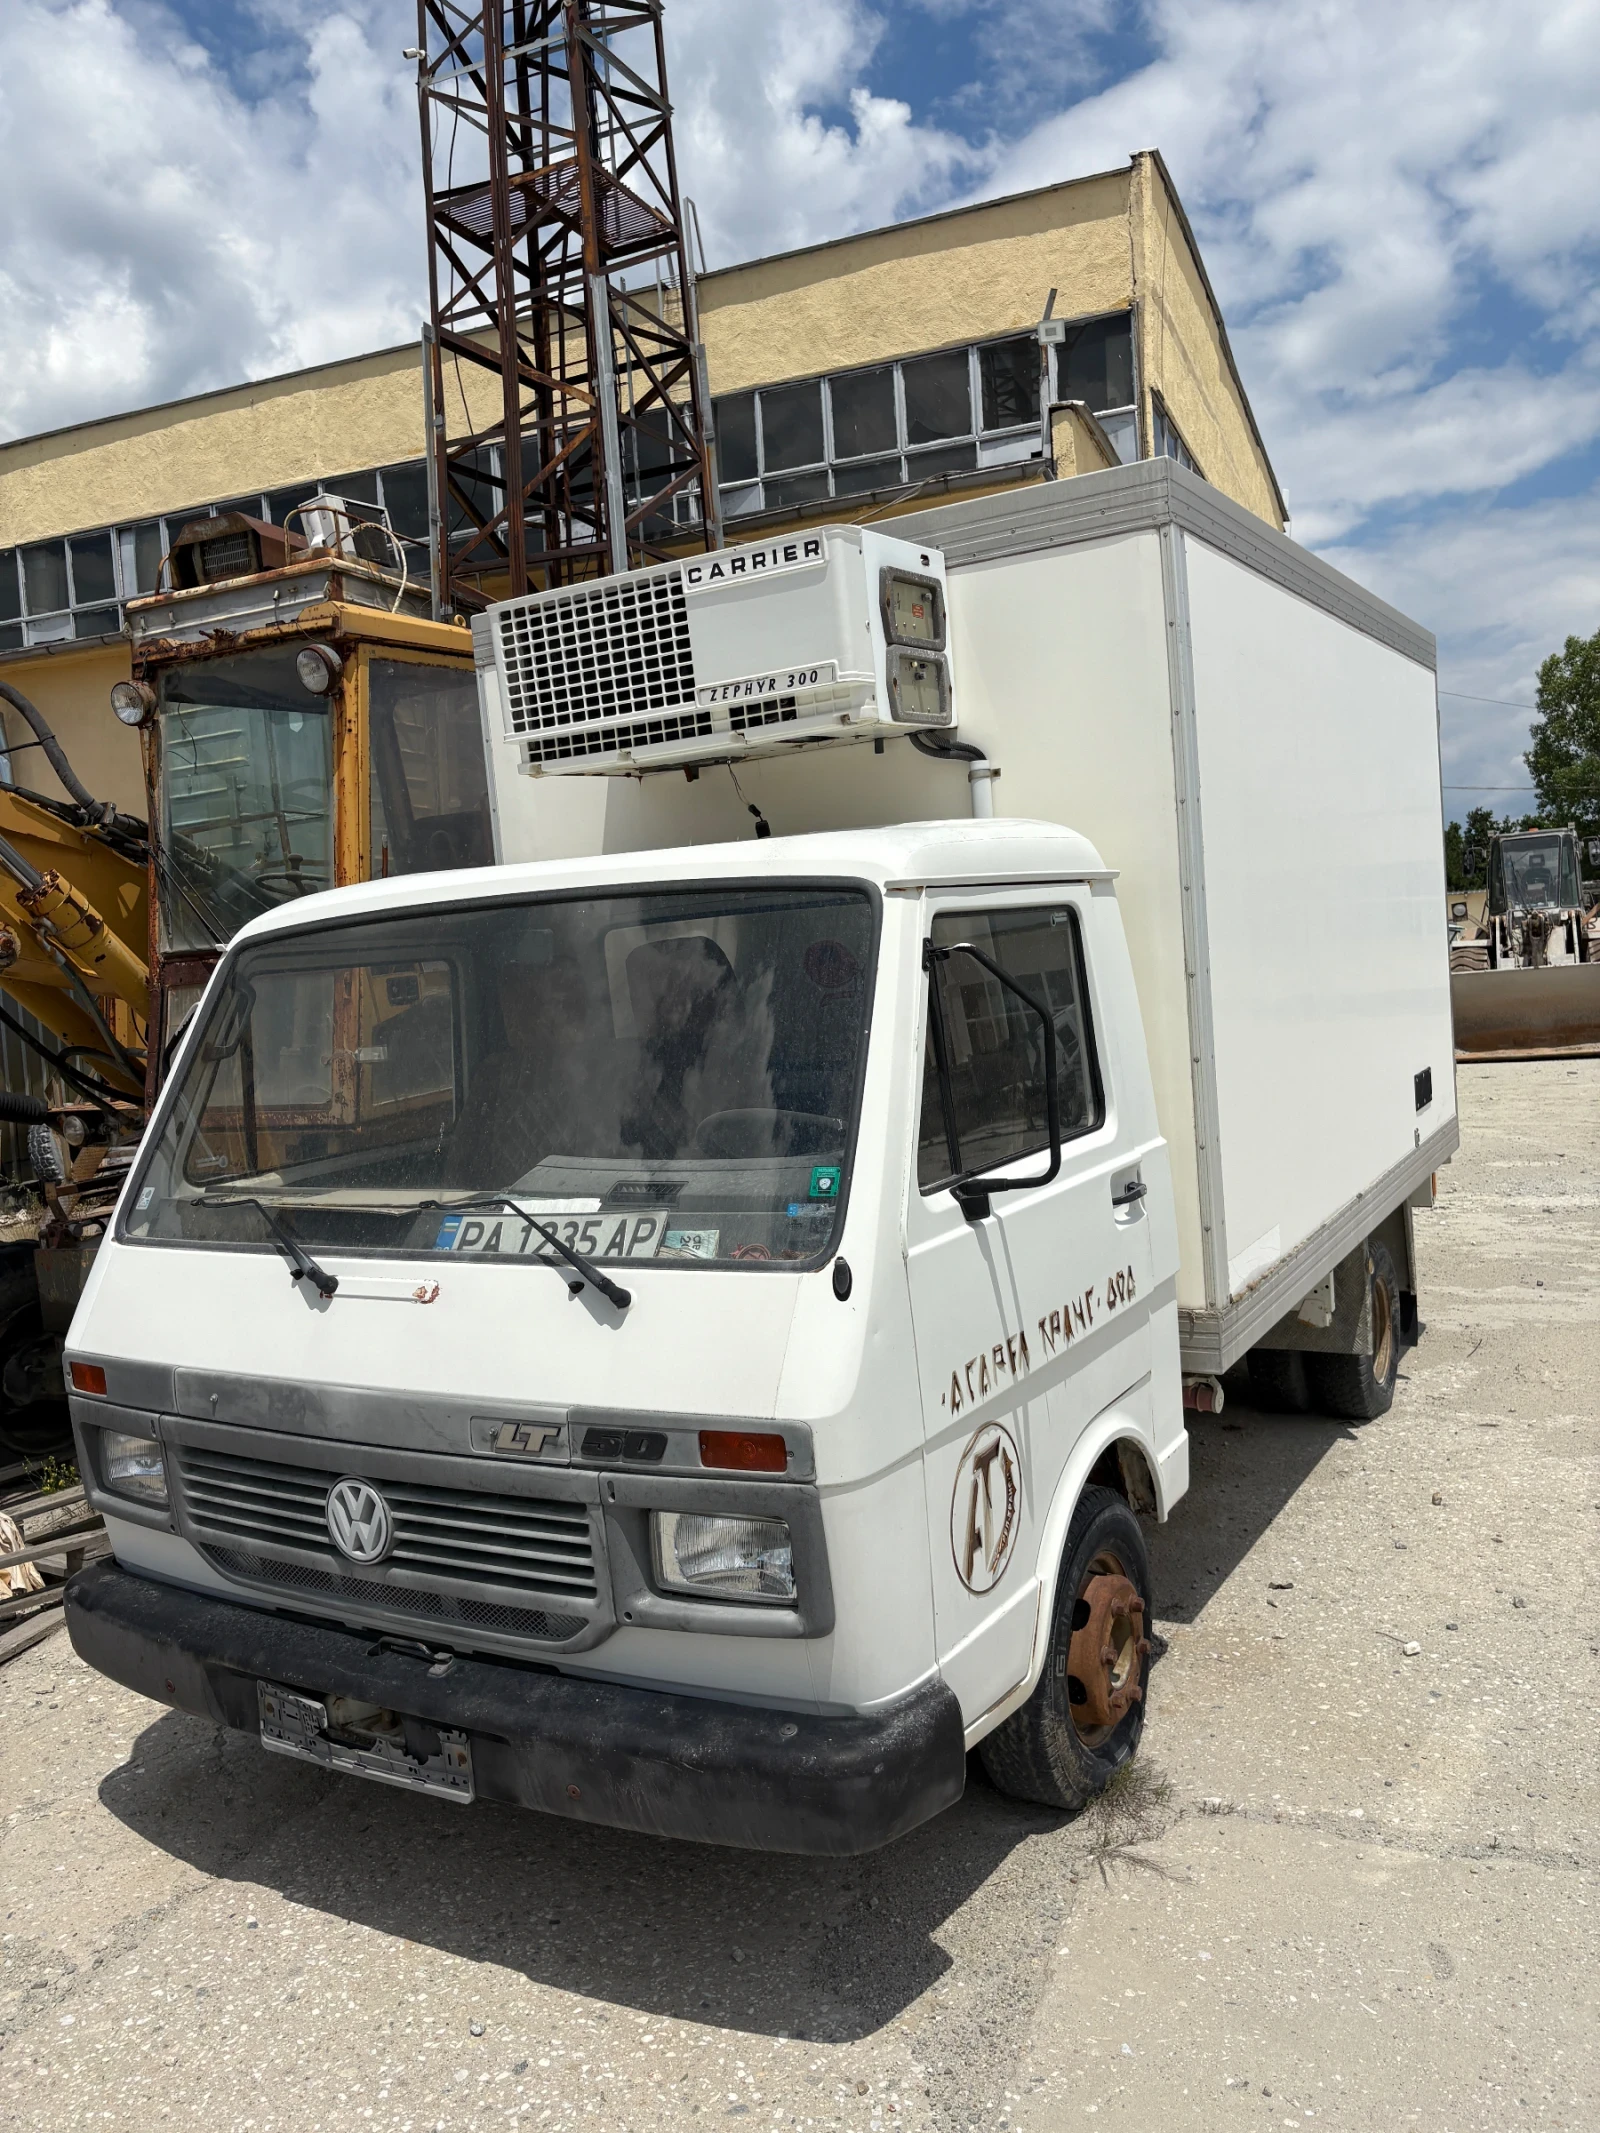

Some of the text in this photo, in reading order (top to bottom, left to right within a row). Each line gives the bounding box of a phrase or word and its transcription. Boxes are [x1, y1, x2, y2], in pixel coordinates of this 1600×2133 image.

[687, 539, 821, 584] CARRIER
[710, 669, 819, 702] ZEPHYR 300
[457, 1217, 658, 1256] PA 1235 AP
[495, 1422, 668, 1461] LT 50
[328, 1480, 388, 1561] VW
